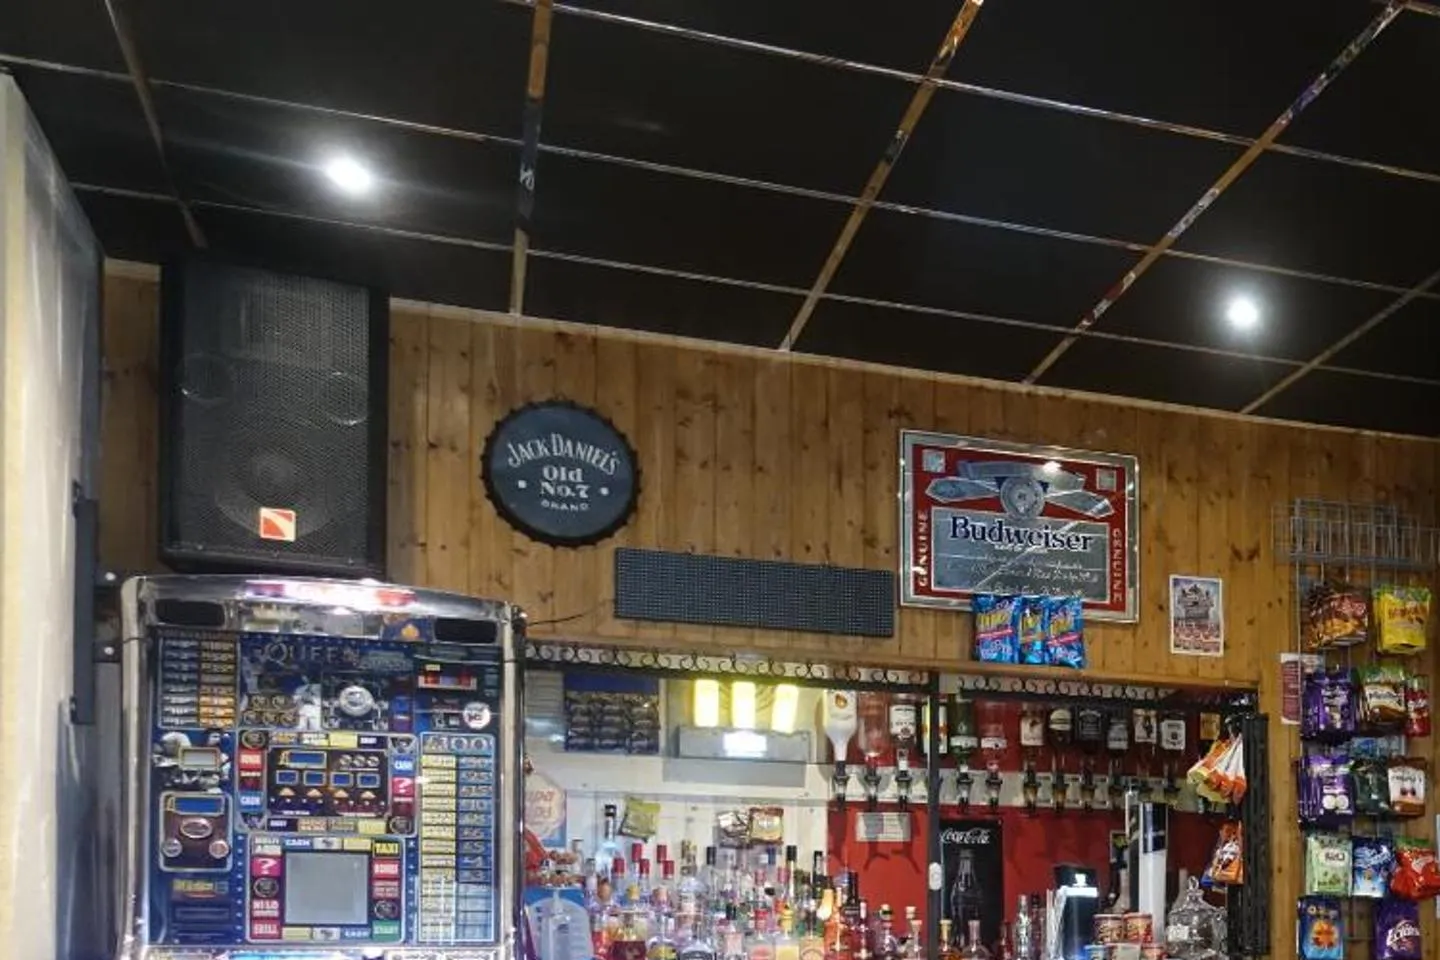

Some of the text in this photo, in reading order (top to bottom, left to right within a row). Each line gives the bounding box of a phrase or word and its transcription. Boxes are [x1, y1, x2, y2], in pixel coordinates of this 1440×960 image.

[507, 432, 620, 476] JACK DANIEL'S
[542, 464, 584, 483] Old
[541, 499, 590, 512] BRAND
[950, 515, 1094, 552] Budweiser
[940, 827, 991, 845] Coca-Cola
